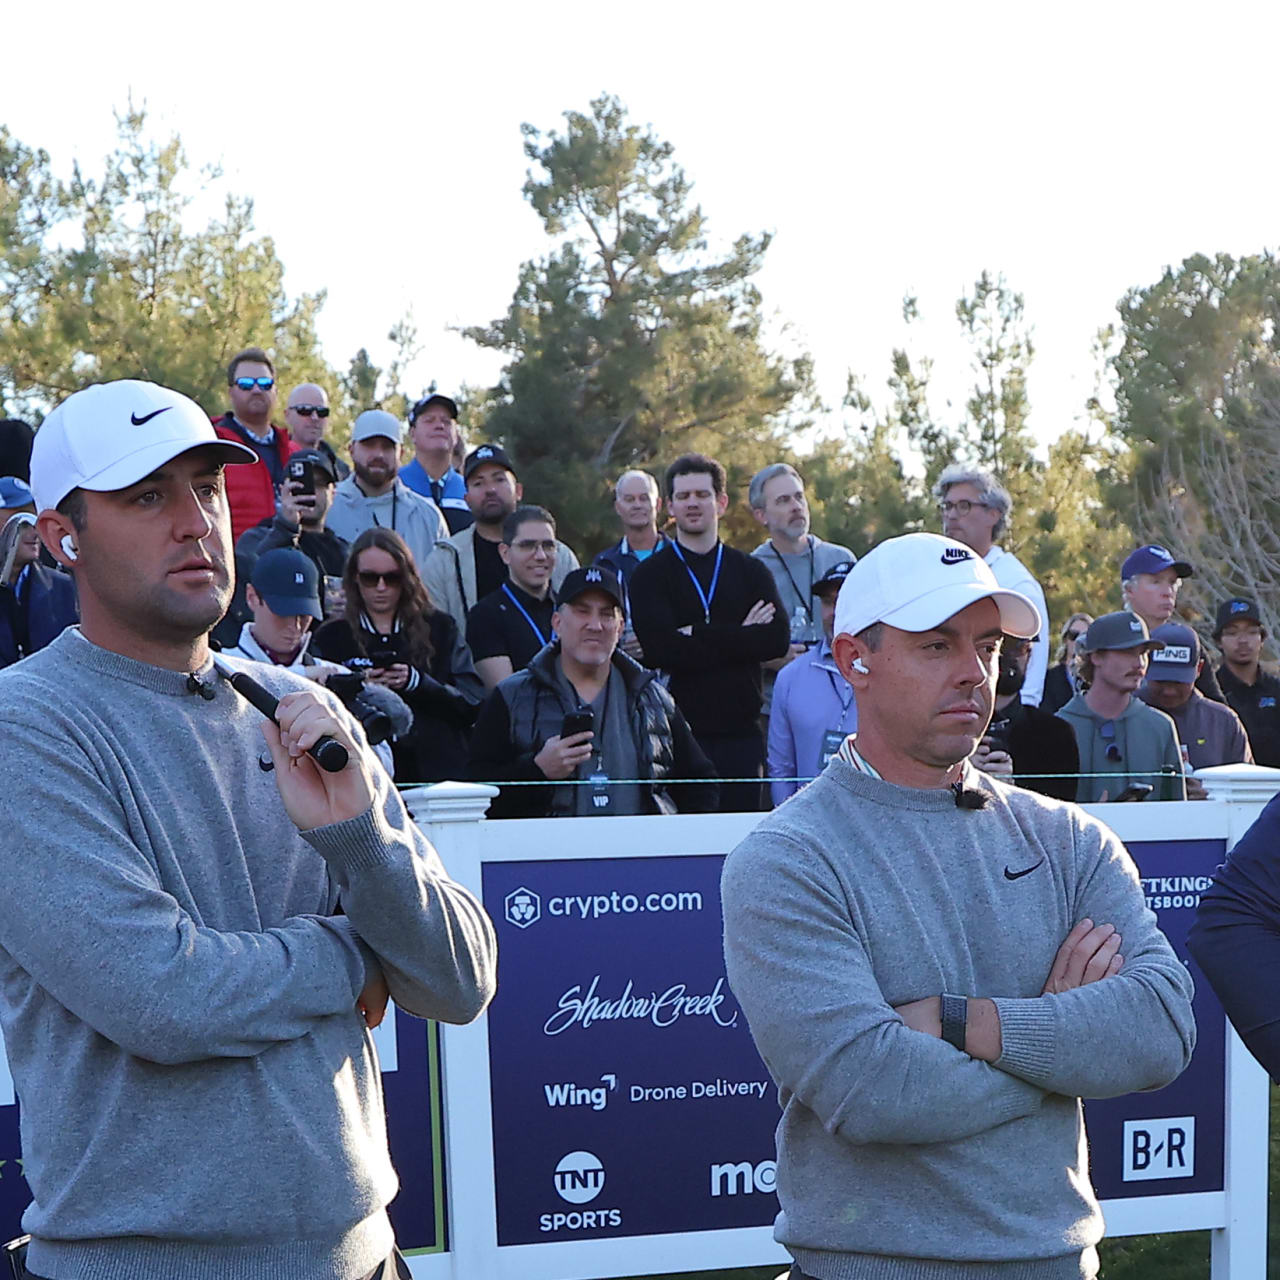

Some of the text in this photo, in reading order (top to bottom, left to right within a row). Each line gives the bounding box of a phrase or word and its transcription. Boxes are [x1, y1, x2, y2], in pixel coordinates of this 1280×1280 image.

[1156, 649, 1188, 659] PING
[592, 795, 609, 807] VIP
[548, 891, 703, 918] crypto.com
[544, 1079, 768, 1111] Wing Drone Delivery
[539, 1209, 622, 1232] SPORTS
